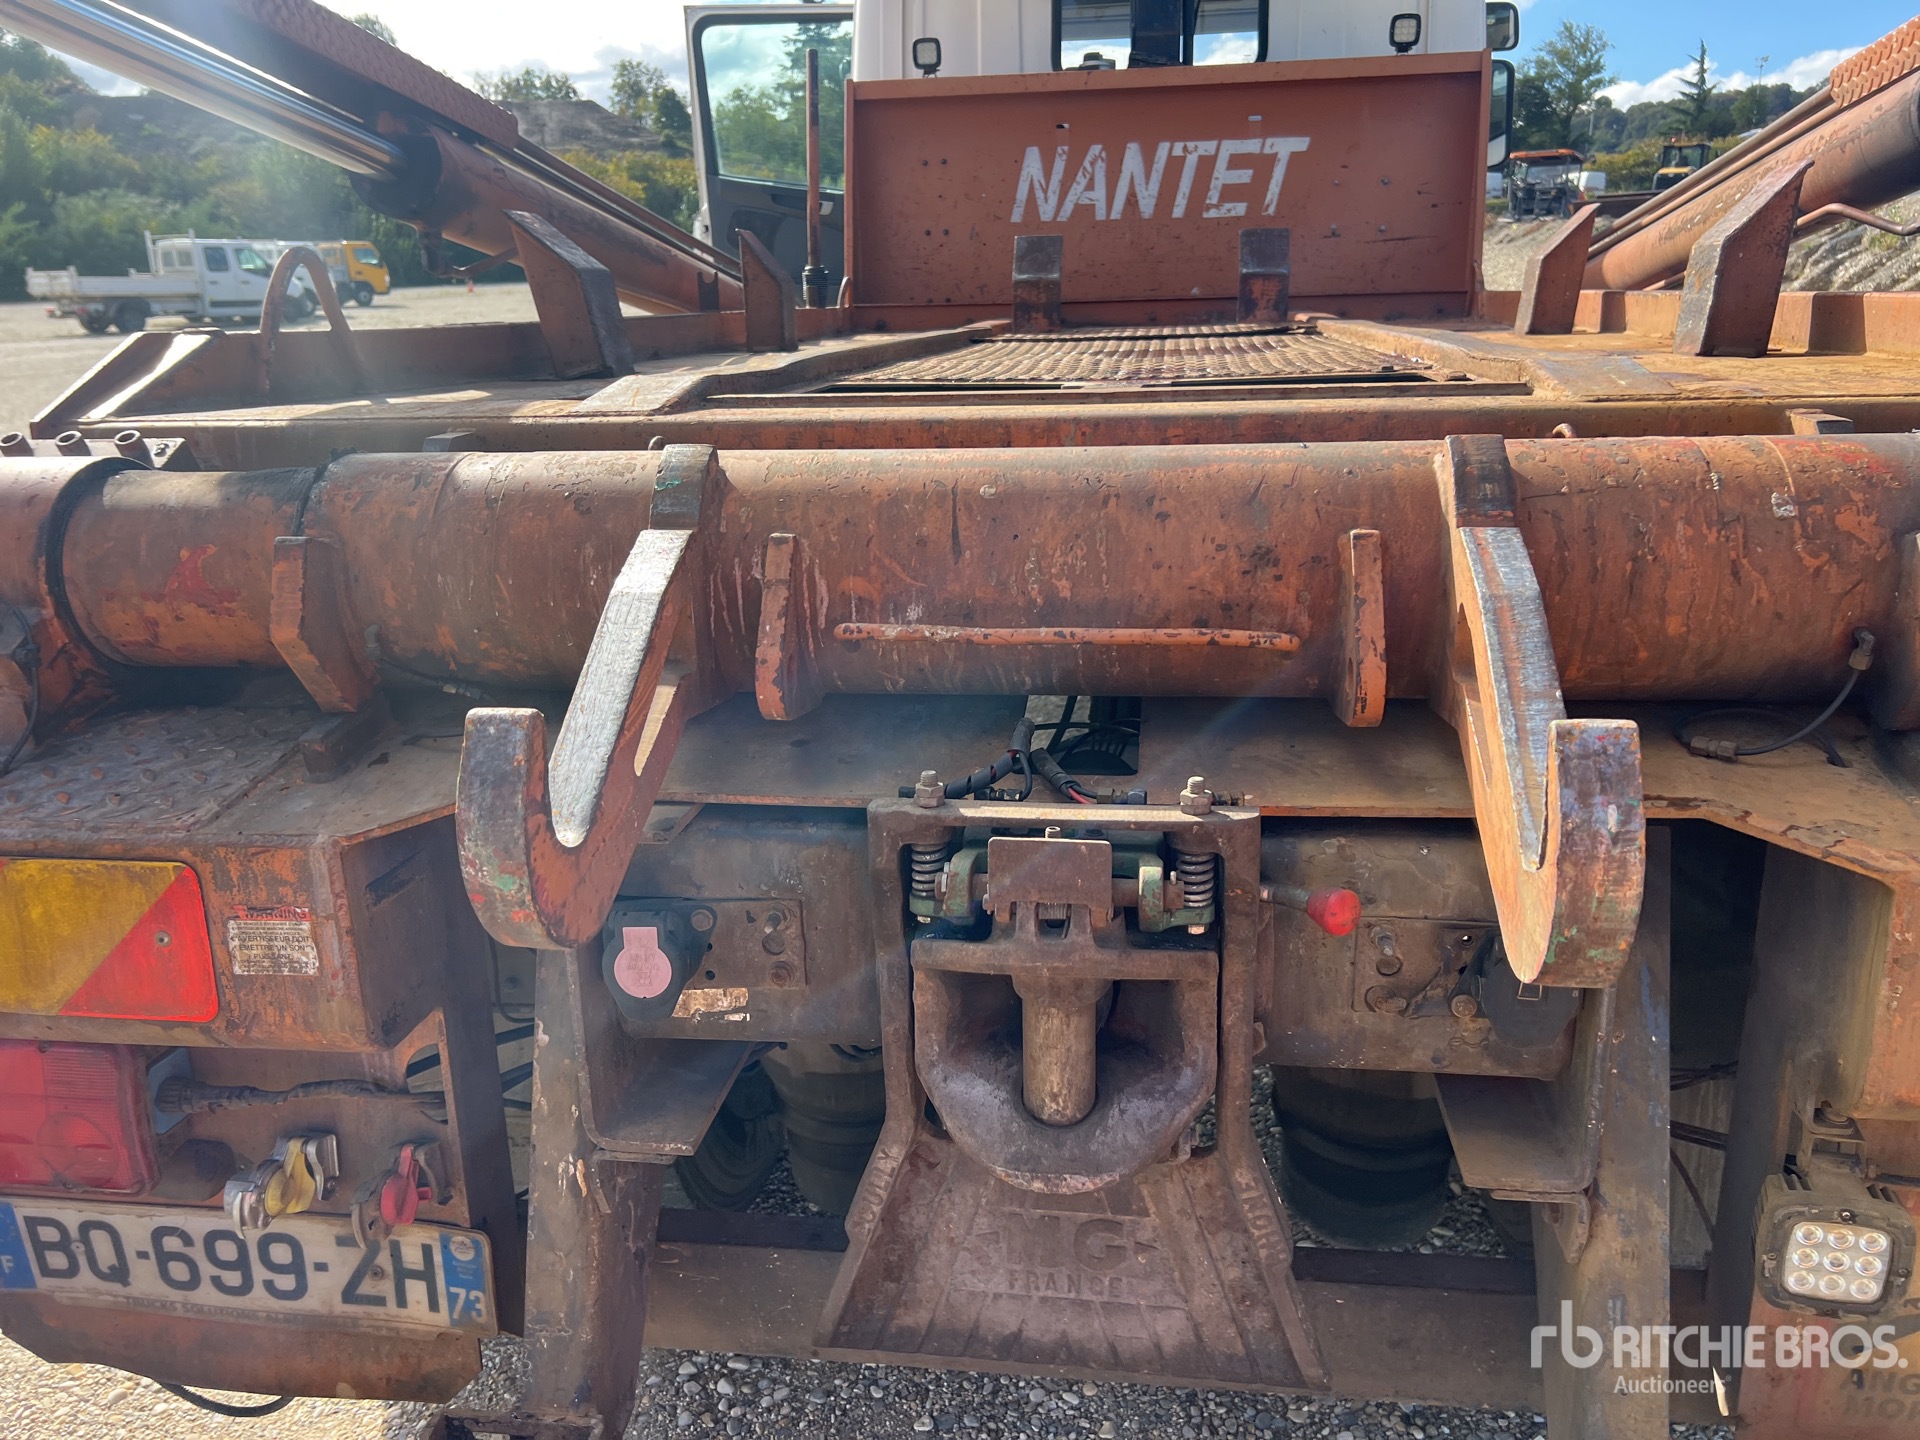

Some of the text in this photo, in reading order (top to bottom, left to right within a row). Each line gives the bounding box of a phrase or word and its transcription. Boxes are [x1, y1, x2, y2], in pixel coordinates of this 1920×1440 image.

[1010, 137, 1311, 223] NANTET
[23, 1215, 441, 1314] BQ-699-ZH
[449, 1286, 487, 1323] 73
